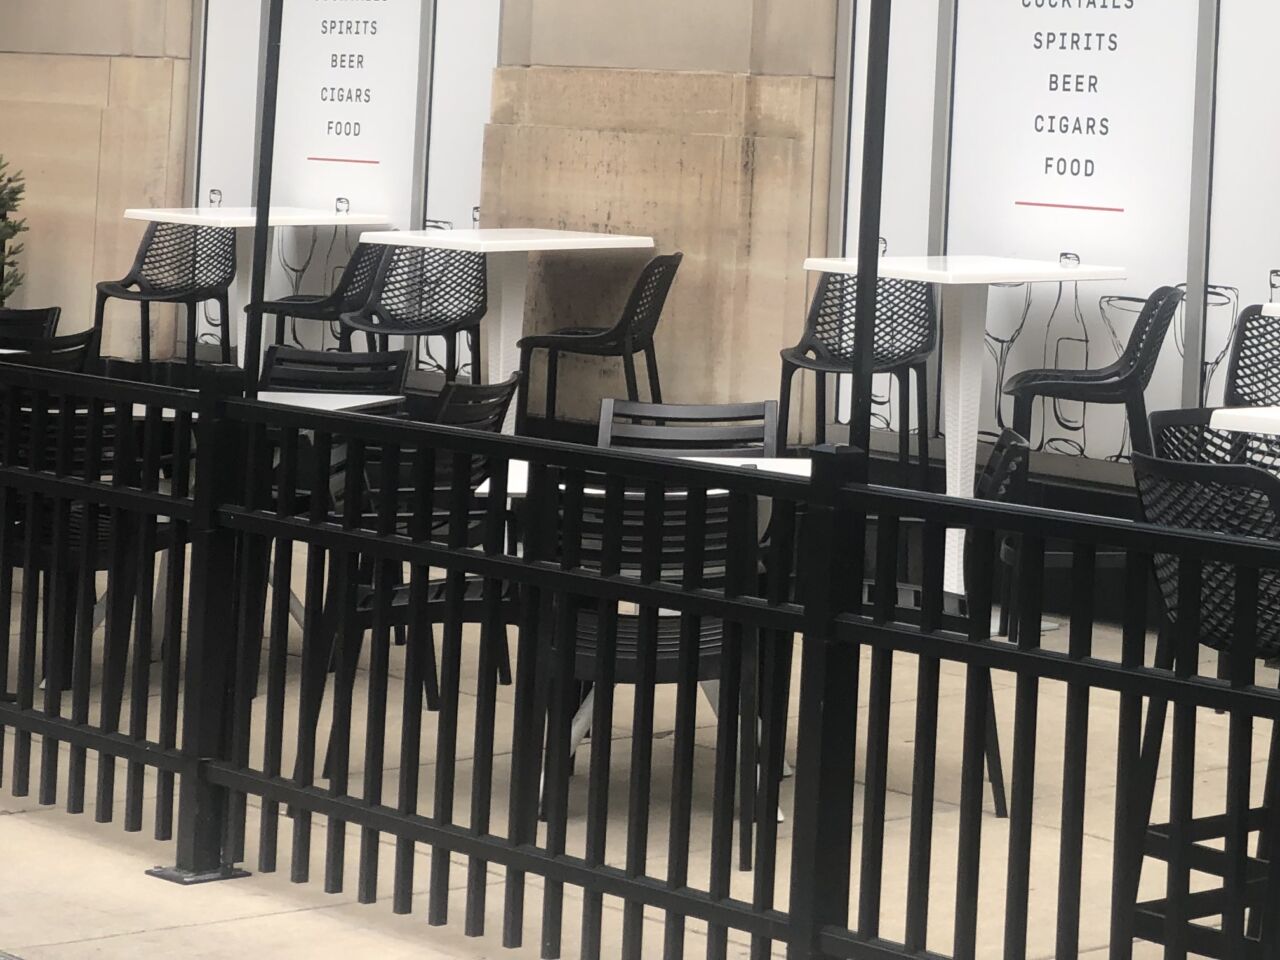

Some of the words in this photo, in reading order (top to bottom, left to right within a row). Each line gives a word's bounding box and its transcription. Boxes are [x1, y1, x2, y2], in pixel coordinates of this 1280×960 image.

[320, 20, 378, 35] SPIRITS
[1033, 31, 1118, 51] SPIRITS
[330, 53, 364, 69] BEER
[1048, 73, 1099, 93] BEER
[320, 86, 371, 103] CIGARS
[327, 120, 361, 136] FOOD
[1034, 114, 1110, 136] CIGARS
[1044, 157, 1095, 177] FOOD
